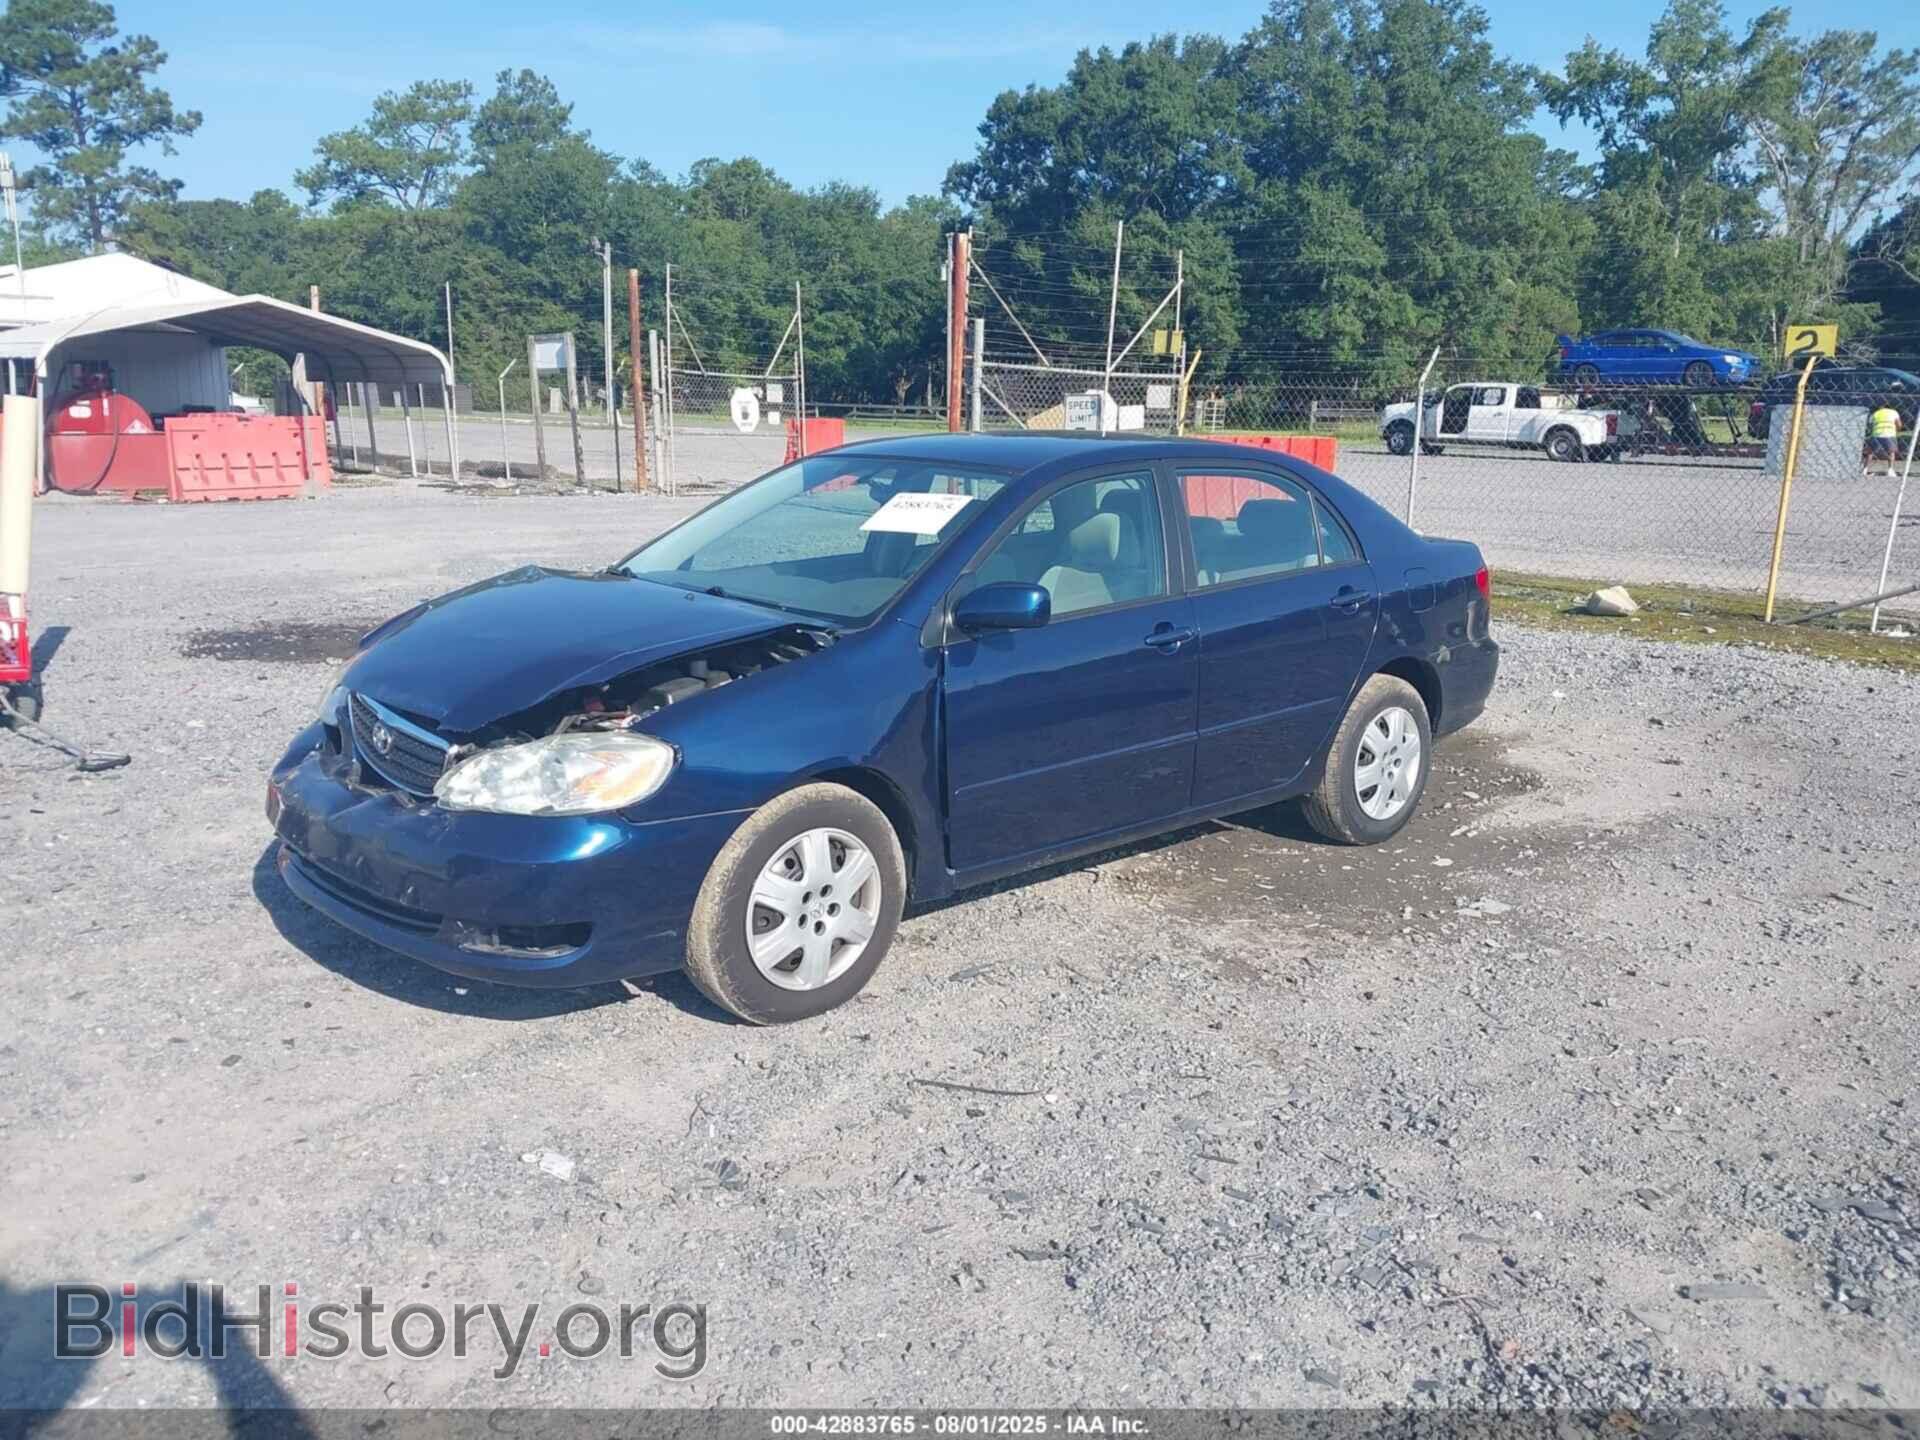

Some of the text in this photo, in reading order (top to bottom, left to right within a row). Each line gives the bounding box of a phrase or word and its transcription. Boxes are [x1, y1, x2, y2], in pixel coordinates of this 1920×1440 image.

[1790, 330, 1825, 356] 2
[1068, 400, 1097, 410] SPEED
[1069, 414, 1093, 423] LIMIT
